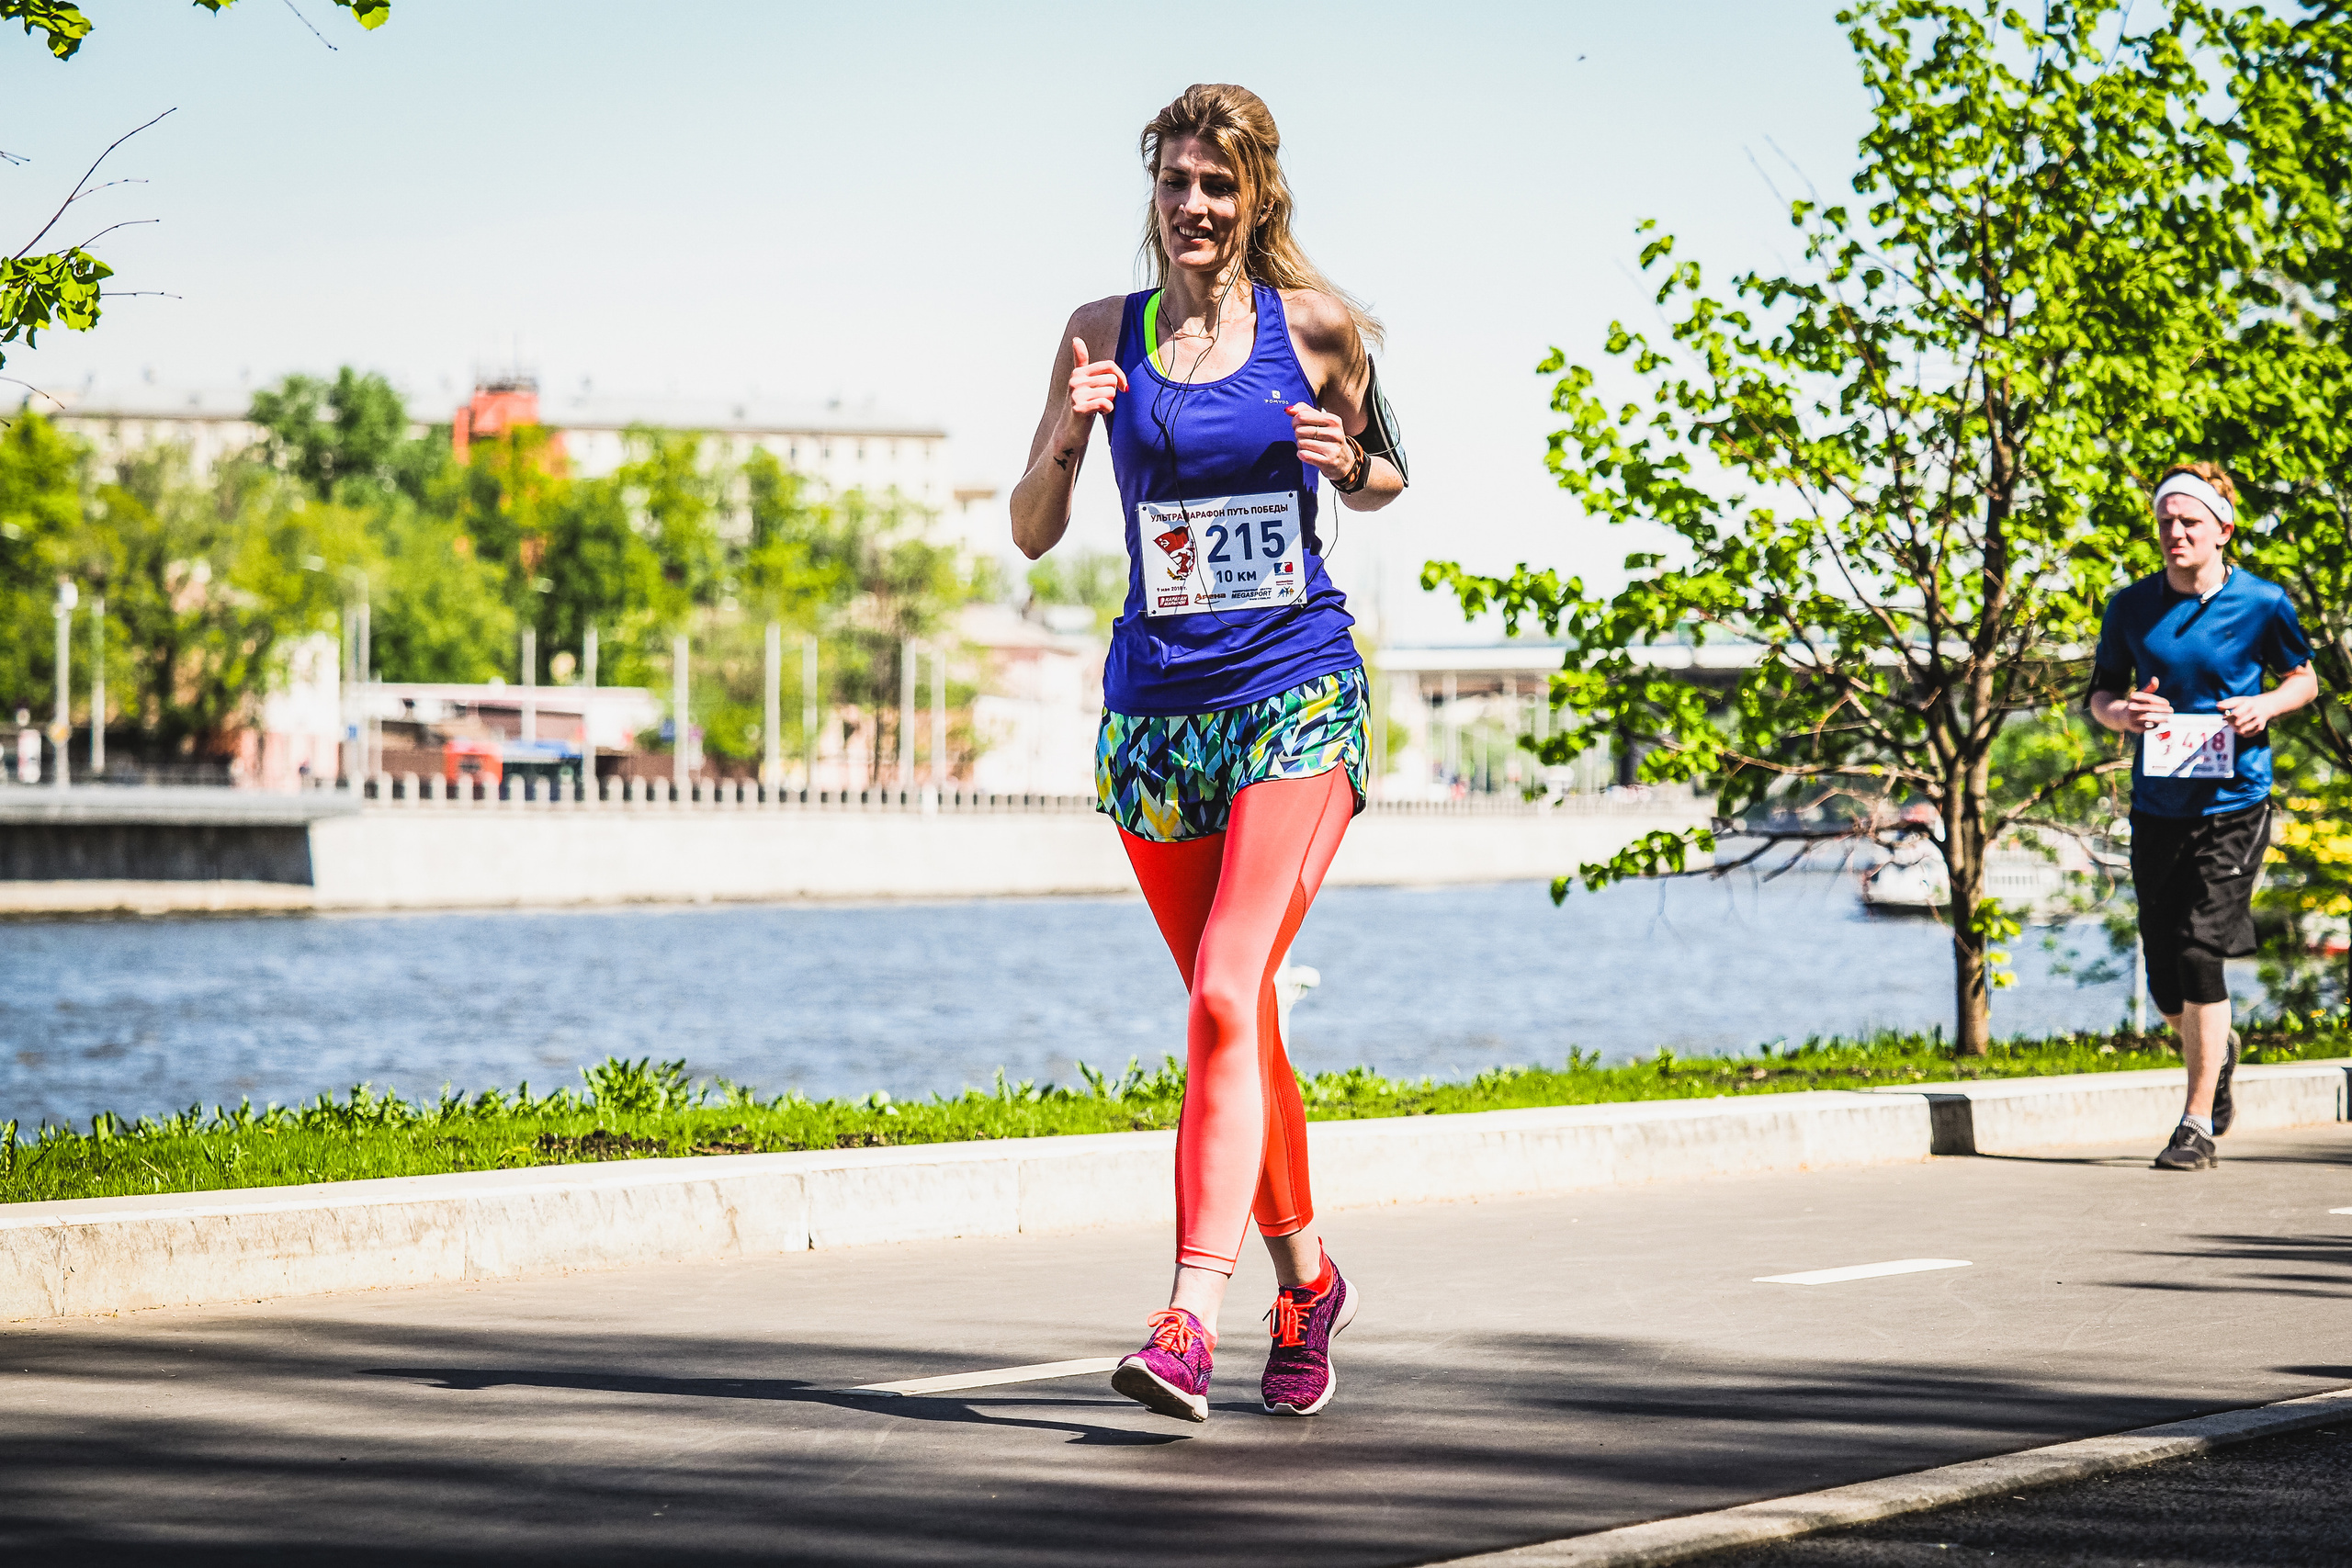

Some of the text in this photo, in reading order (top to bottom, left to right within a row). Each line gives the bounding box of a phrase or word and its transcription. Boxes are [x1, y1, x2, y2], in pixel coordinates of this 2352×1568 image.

[1227, 508, 1249, 516] ПУТЬ
[1251, 504, 1289, 514] ПОБЕДЫ
[1205, 520, 1285, 563] 215
[1216, 570, 1233, 583] 10
[1232, 590, 1272, 599] MEGASPORT
[2182, 732, 2225, 752] 418
